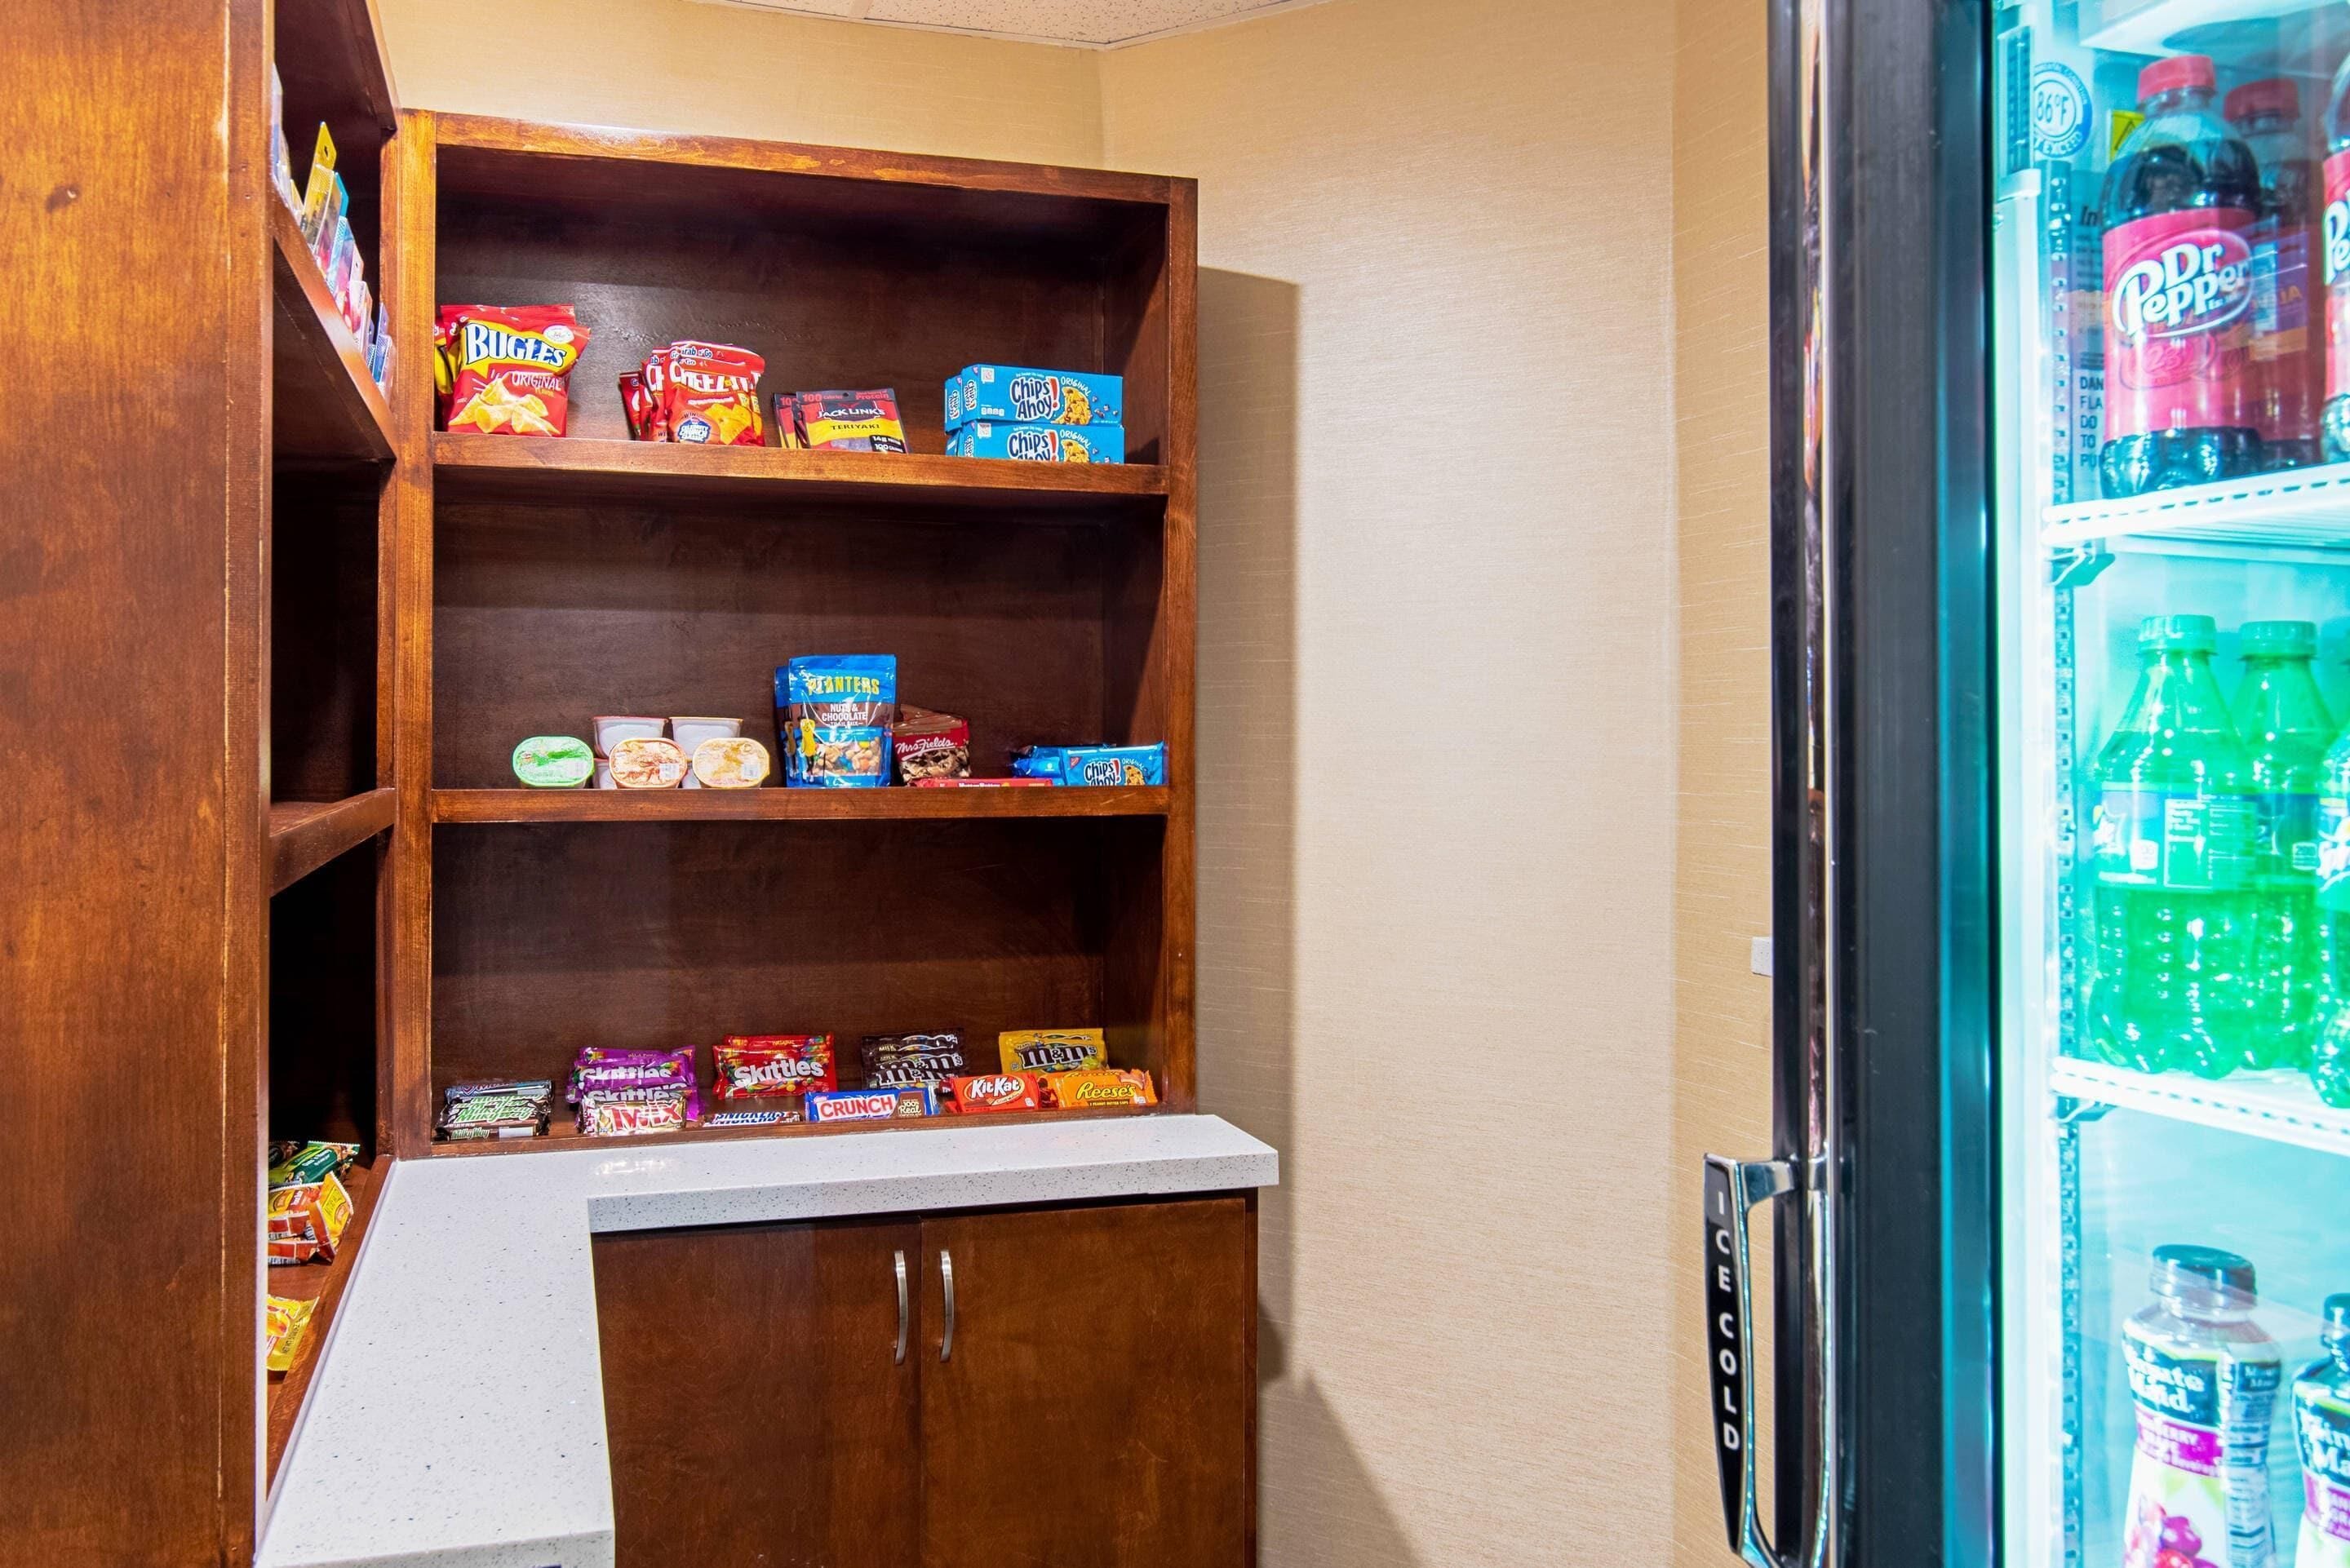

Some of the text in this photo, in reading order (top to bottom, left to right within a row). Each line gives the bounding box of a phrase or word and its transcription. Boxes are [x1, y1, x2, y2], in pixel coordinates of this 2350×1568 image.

[2161, 243, 2225, 289] Dr
[2113, 259, 2249, 338] Pepper
[465, 322, 567, 365] BUGLES
[681, 346, 697, 356] rab
[1011, 377, 1051, 404] Chips
[1060, 375, 1092, 397] ORIGINAL
[2080, 377, 2104, 390] DAN
[802, 393, 822, 402] 100
[2080, 396, 2103, 410] FLA
[1009, 432, 1049, 458] Chips
[1060, 429, 1092, 450] ORIGINAL
[2080, 454, 2098, 468] PU
[807, 675, 880, 696] PLANTERS
[822, 712, 868, 722] CHOCOLATE
[734, 1058, 825, 1088] Skittles
[820, 1096, 893, 1118] CRUNCH
[1716, 1190, 1740, 1451] ICE COLD
